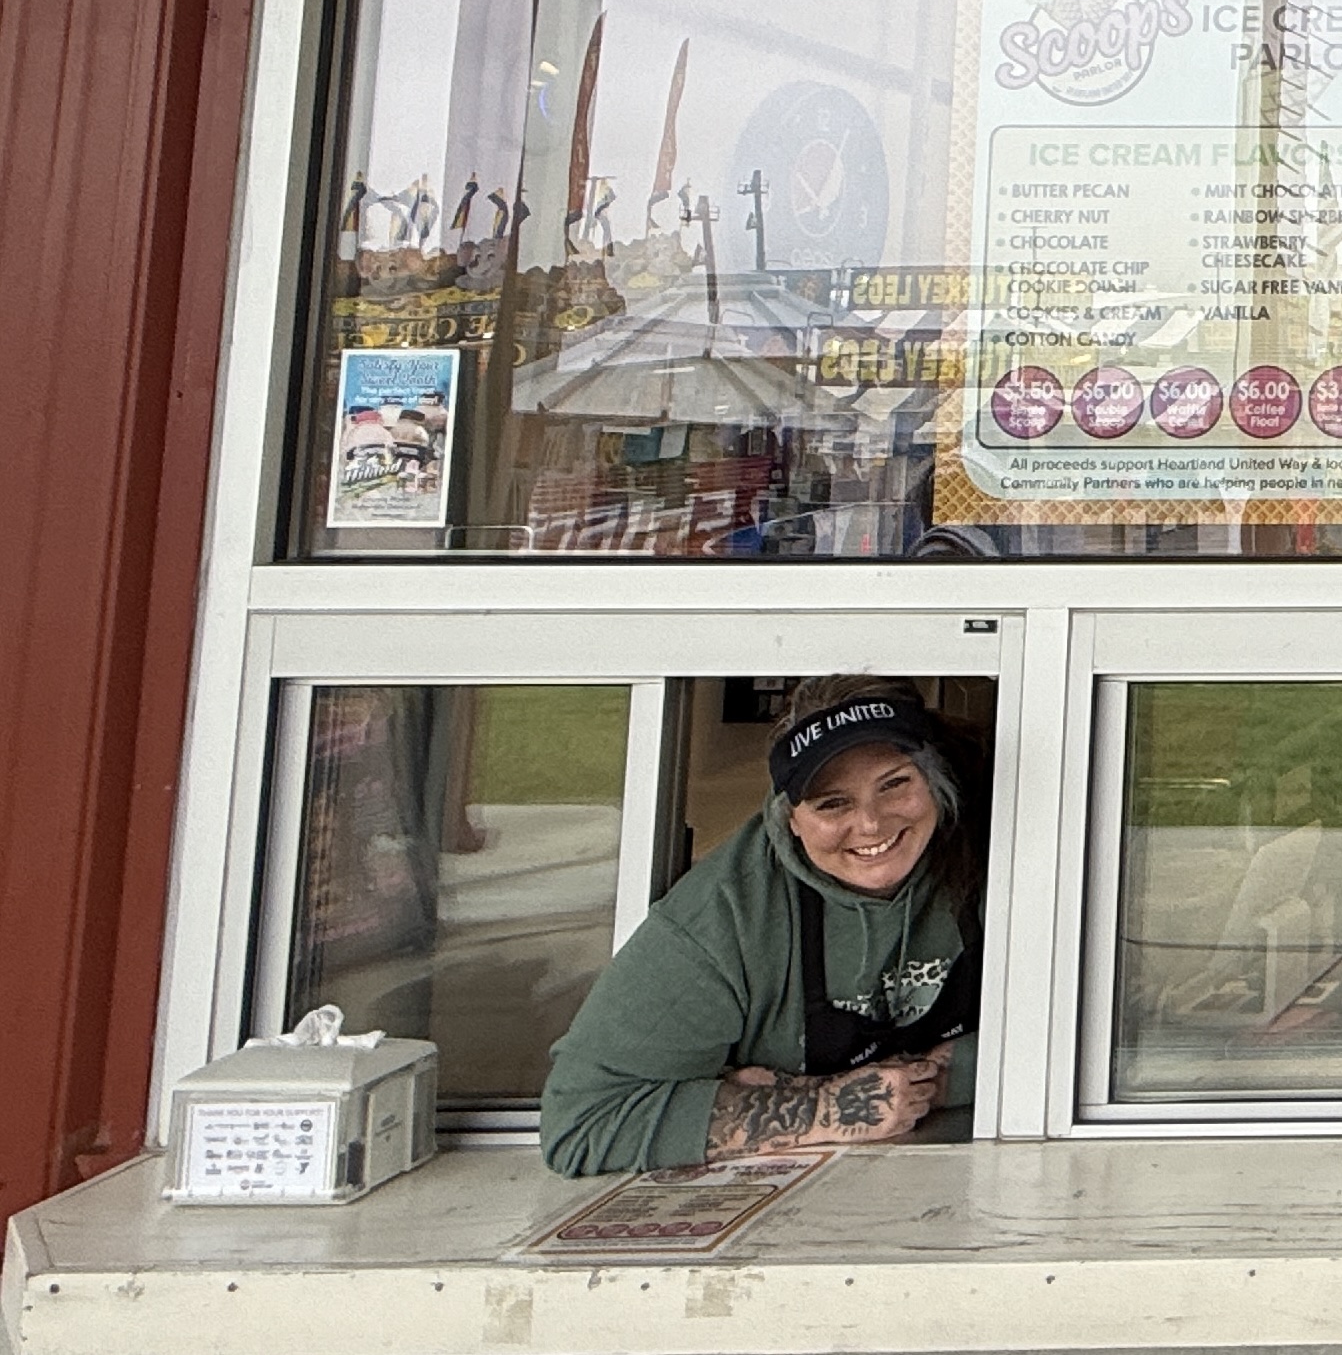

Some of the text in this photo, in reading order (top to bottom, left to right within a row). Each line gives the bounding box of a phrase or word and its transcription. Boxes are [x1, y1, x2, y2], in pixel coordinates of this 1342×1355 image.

[1202, 5, 1260, 33] ICE
[1029, 144, 1079, 166] ICE
[1089, 144, 1201, 166] CREAM
[1012, 184, 1130, 199] BUTTER PECAN
[1204, 184, 1248, 199] MINT
[1011, 210, 1110, 225] CHERRY NUT
[1009, 235, 1108, 250] CHOCOLATE
[1203, 235, 1308, 250] STRAWBERRY
[1008, 261, 1149, 276] CHOCOLATE CHIP
[1202, 254, 1308, 269] CHEESECAKE
[1201, 280, 1299, 295] SUGAR FREE
[1005, 332, 1071, 348] COTTON
[1083, 381, 1134, 401] $6.00
[1238, 381, 1290, 401] $6.00
[1010, 457, 1028, 471] All
[1032, 458, 1097, 473] proceeds
[1101, 459, 1153, 473] support
[1229, 457, 1275, 471] United
[1279, 458, 1308, 473] Way
[790, 703, 895, 757] LIVE UNITED
